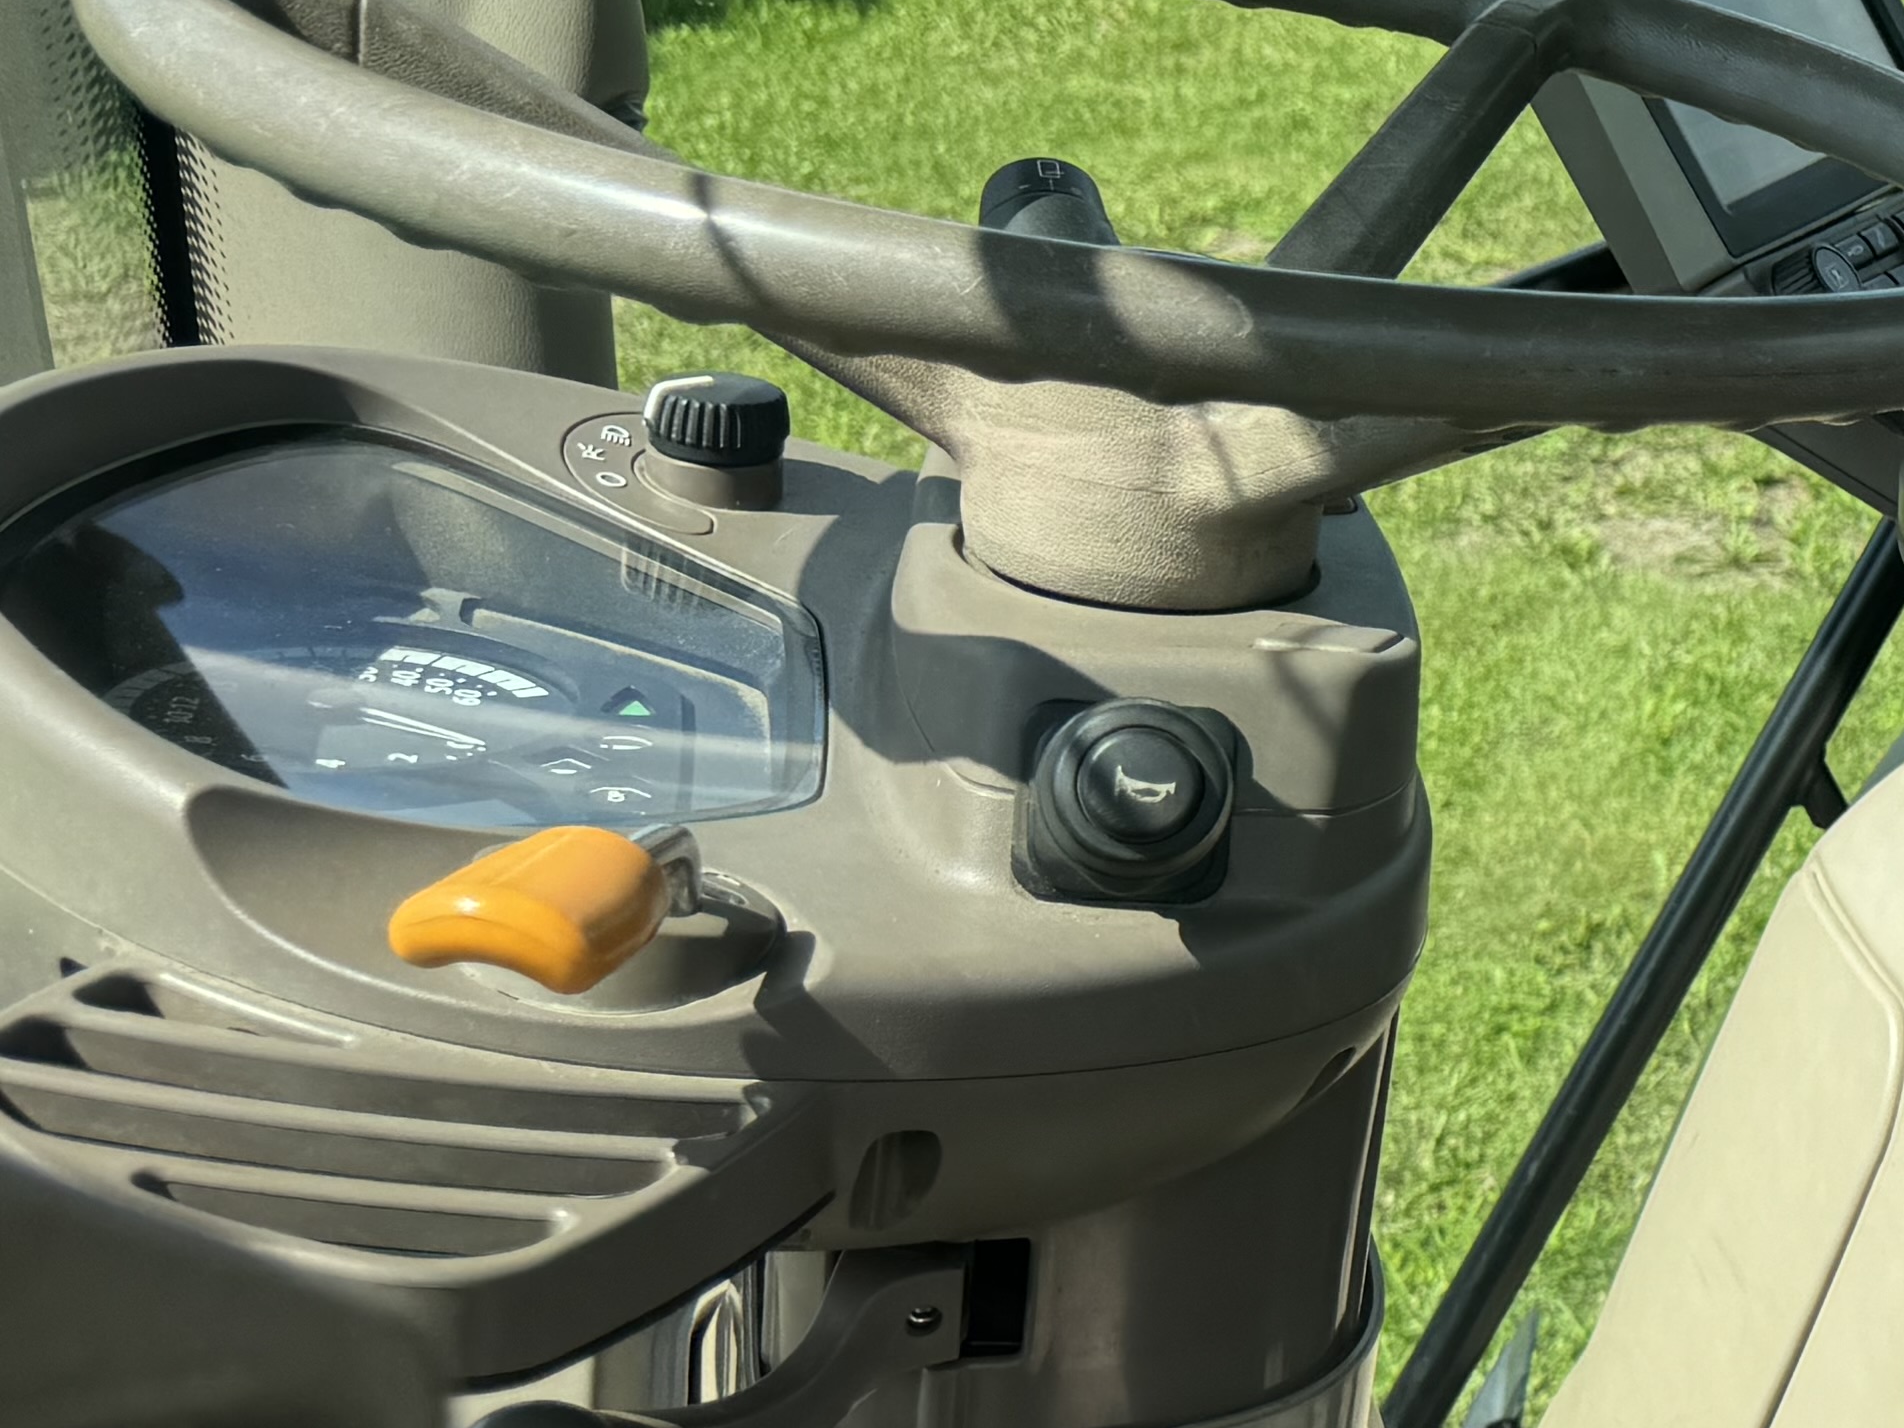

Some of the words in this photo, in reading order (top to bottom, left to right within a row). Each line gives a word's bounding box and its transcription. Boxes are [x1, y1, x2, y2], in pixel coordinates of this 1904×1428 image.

[390, 670, 421, 687] 40
[424, 678, 454, 695] 50
[452, 689, 482, 706] 60
[315, 758, 346, 769] 4
[387, 753, 418, 763] 2
